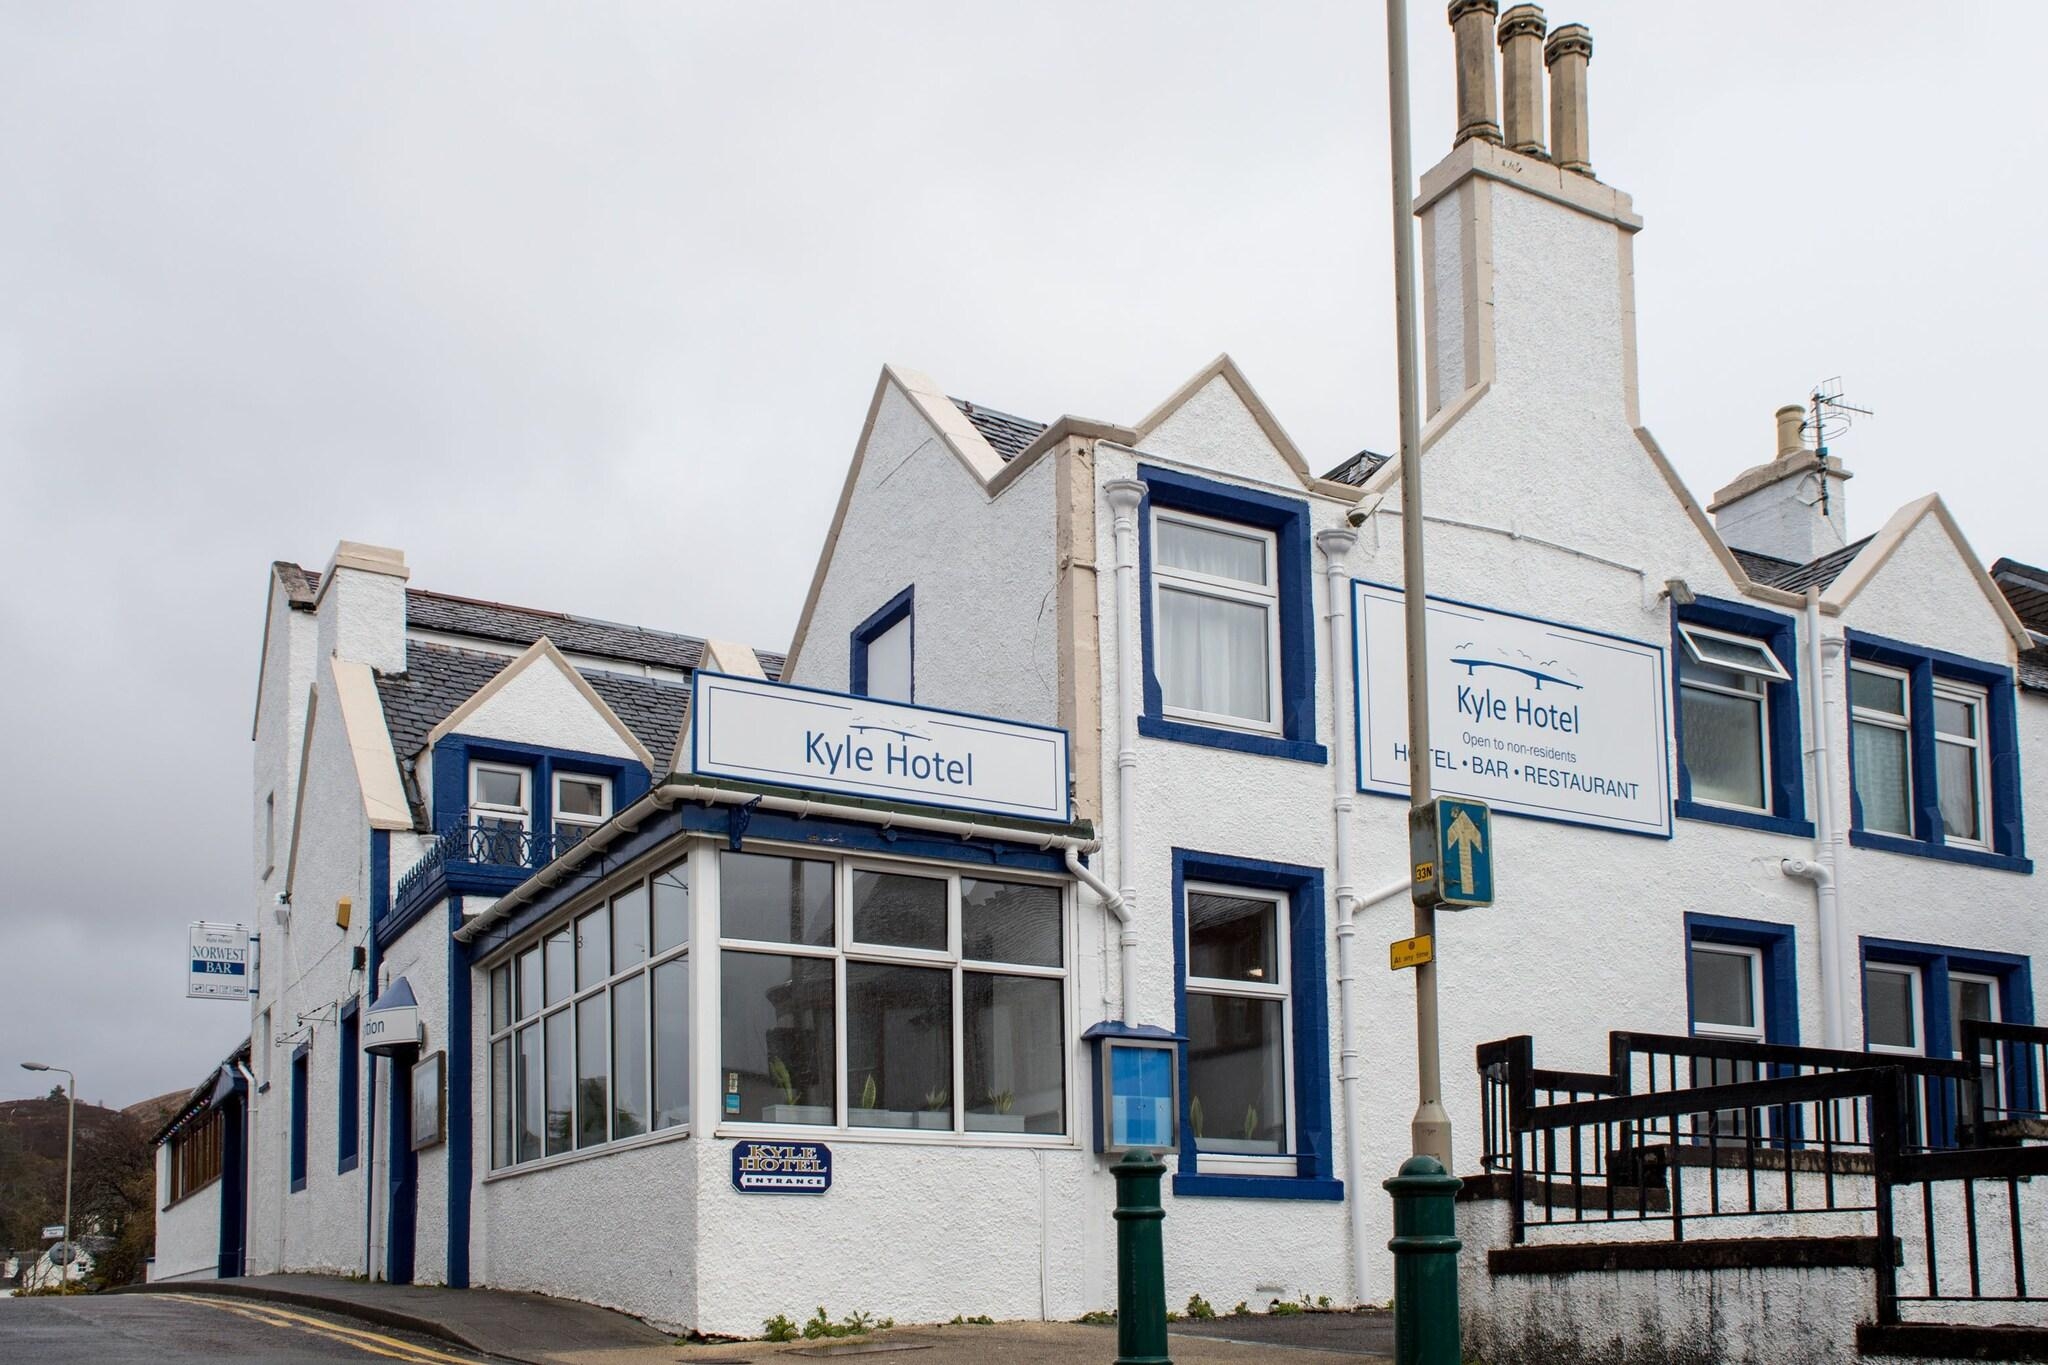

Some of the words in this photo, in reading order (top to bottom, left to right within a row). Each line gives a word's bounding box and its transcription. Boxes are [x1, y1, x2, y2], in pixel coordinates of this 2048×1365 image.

[1457, 685, 1507, 723] Kyle
[1516, 696, 1579, 734] Hotel
[1462, 731, 1491, 751] Open
[1493, 738, 1504, 751] to
[1507, 743, 1577, 763] non-residents
[806, 730, 873, 775] Kyle
[887, 743, 972, 786] Hotel
[1394, 742, 1457, 770] HEL
[1472, 756, 1509, 779] BAR
[1524, 765, 1639, 800] RESTAURANT
[1416, 865, 1432, 880] 33N
[192, 945, 246, 961] NORWEST
[206, 961, 232, 974] BAR
[747, 1144, 818, 1160] KYLE
[739, 1157, 828, 1173] HOTEL
[746, 1177, 823, 1185] ENTRANCE
